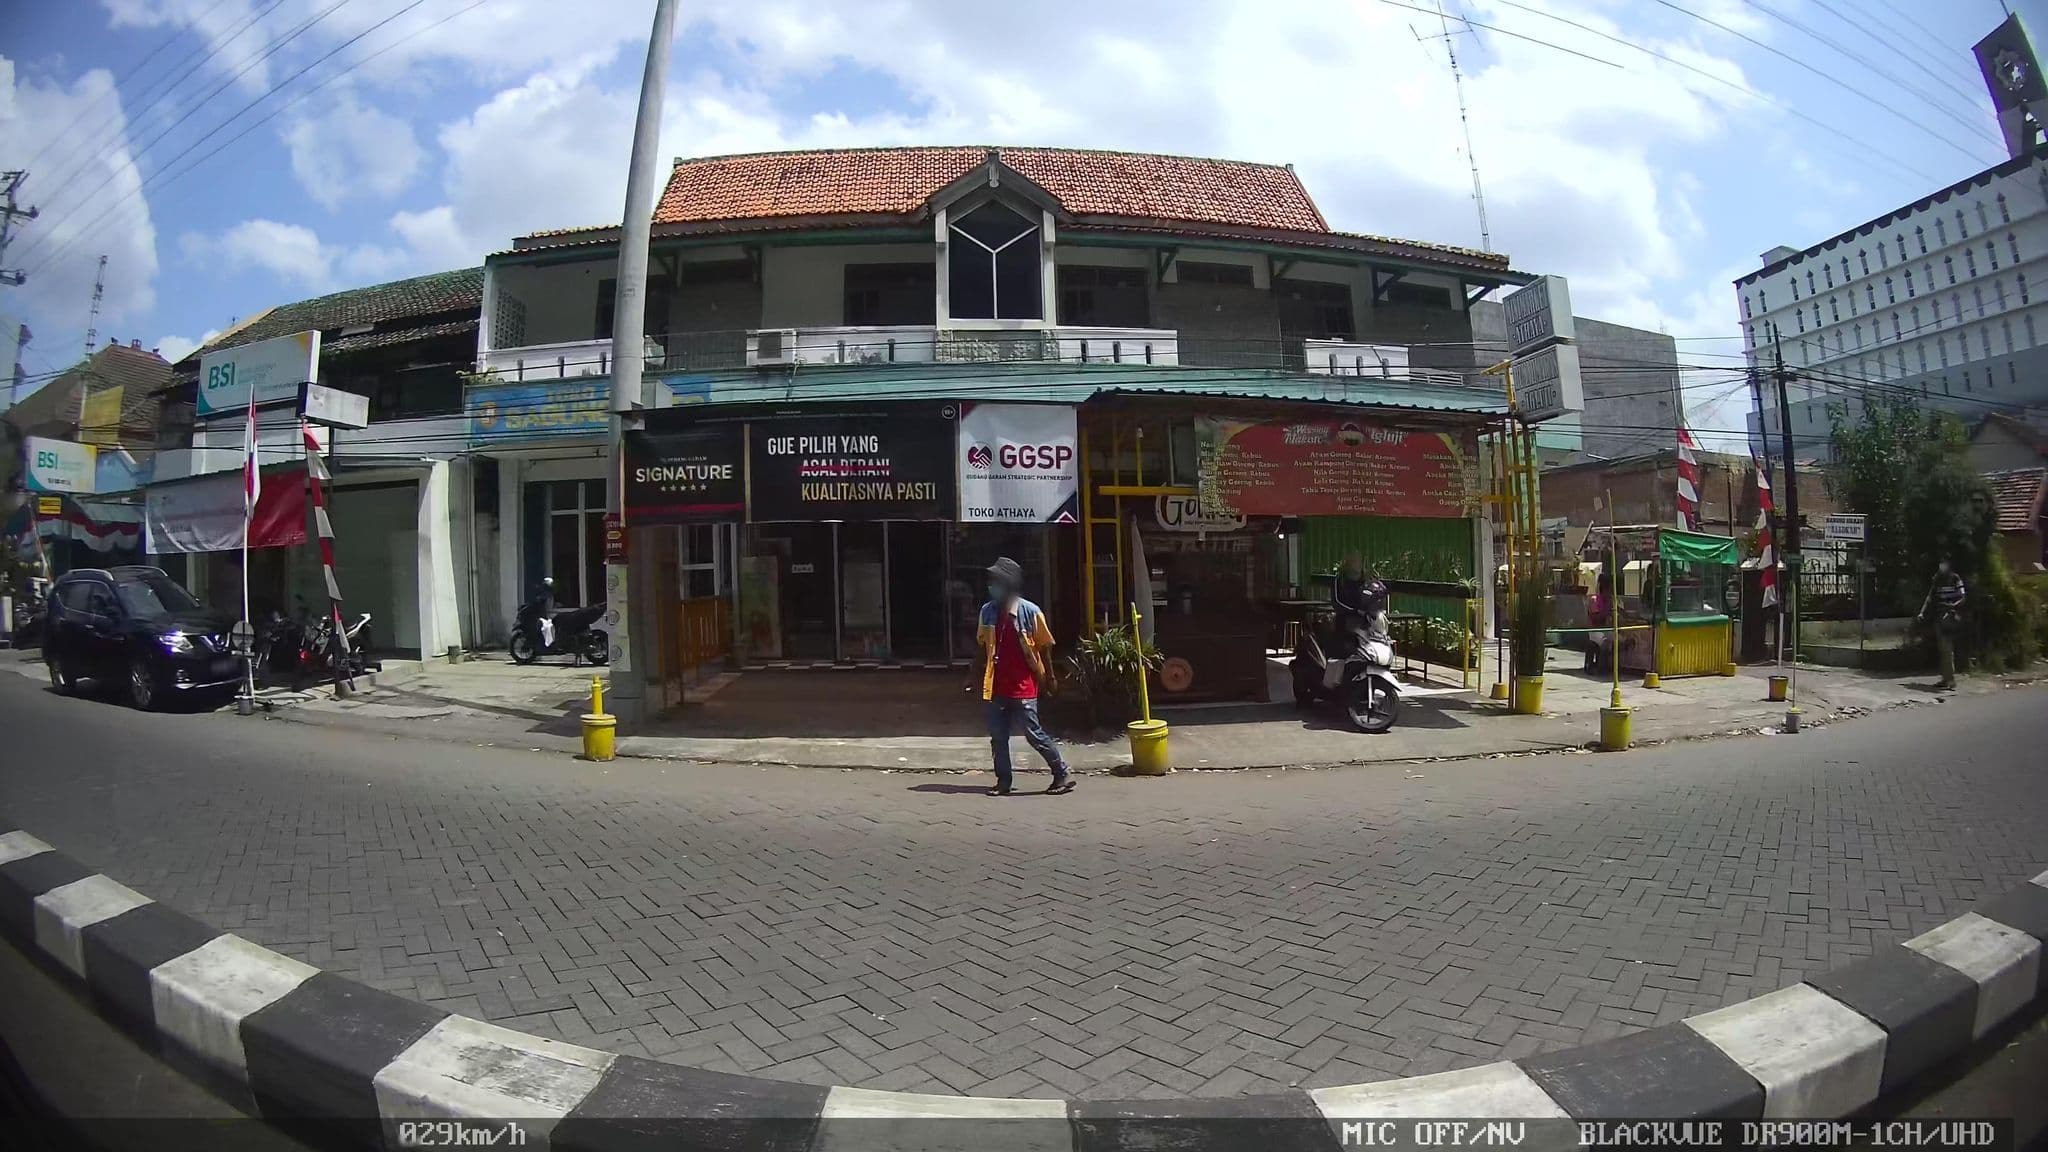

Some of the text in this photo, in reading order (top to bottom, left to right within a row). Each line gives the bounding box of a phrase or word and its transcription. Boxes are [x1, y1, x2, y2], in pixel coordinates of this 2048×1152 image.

[208, 362, 235, 389] BSI
[767, 435, 879, 455] GUE PILIH YANG
[38, 451, 58, 469] BSI
[999, 445, 1072, 469] GGSP
[636, 464, 733, 482] SIGNATURE
[801, 482, 936, 501] KUALITASNYA PASTI
[968, 507, 1036, 518] TOKO ATHAYA
